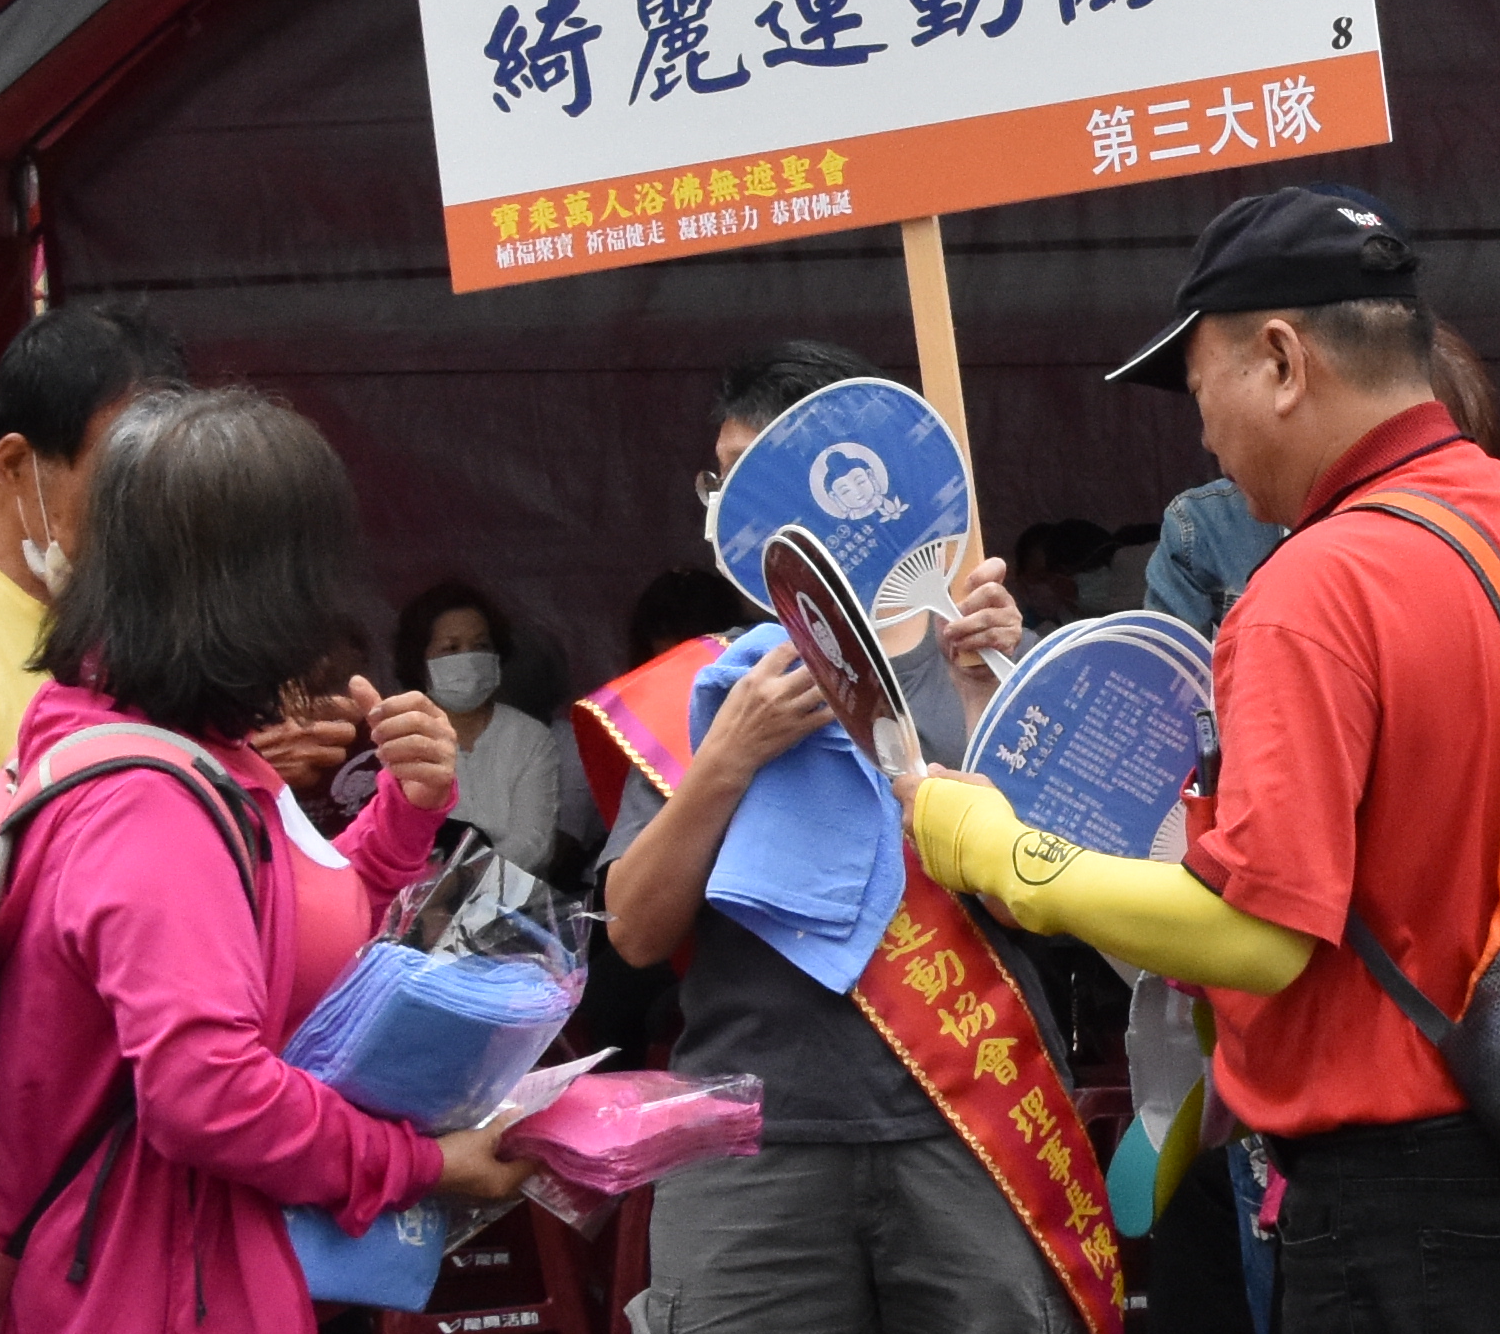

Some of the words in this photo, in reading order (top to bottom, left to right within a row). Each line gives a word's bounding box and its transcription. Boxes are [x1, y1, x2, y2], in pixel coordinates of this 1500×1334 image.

[1331, 16, 1353, 50] 8
[1084, 73, 1322, 175] 第三大隊
[490, 148, 850, 243] 寶乘萬人浴佛無遮聖會
